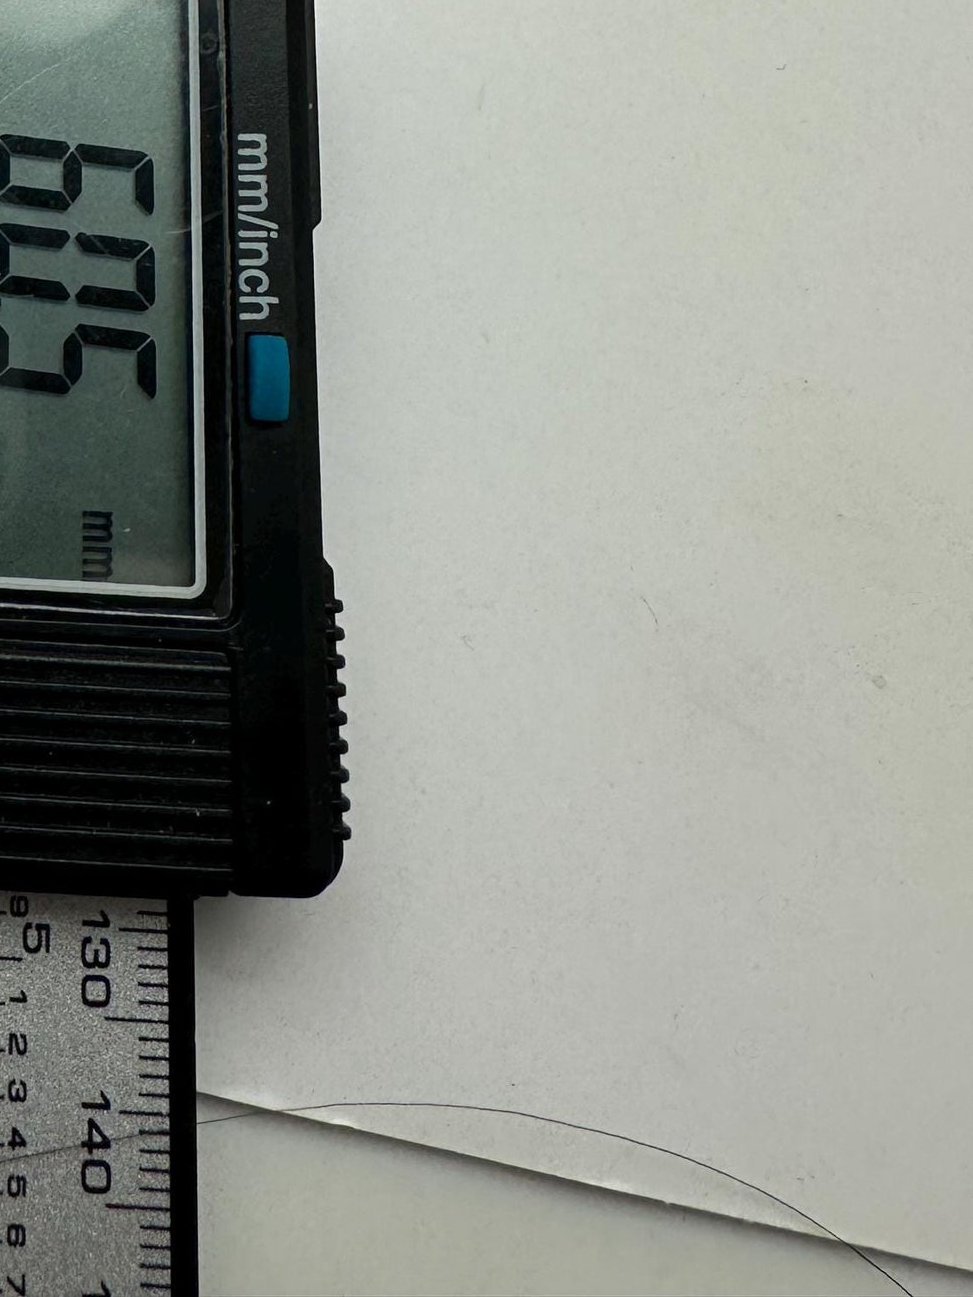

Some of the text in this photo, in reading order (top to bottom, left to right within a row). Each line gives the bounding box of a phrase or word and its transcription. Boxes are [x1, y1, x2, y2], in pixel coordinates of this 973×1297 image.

[238, 133, 279, 320] mm/inch
[82, 510, 114, 580] mm
[9, 895, 29, 918] 9
[22, 922, 51, 954] 5
[81, 910, 112, 1008] 130
[9, 990, 27, 1003] 1
[8, 1033, 27, 1056] 2
[8, 1079, 27, 1103] 3
[8, 1127, 27, 1151] 4
[80, 1091, 111, 1194] 140
[7, 1174, 27, 1199] 5
[7, 1223, 26, 1248] 6
[7, 1274, 26, 1297] 7
